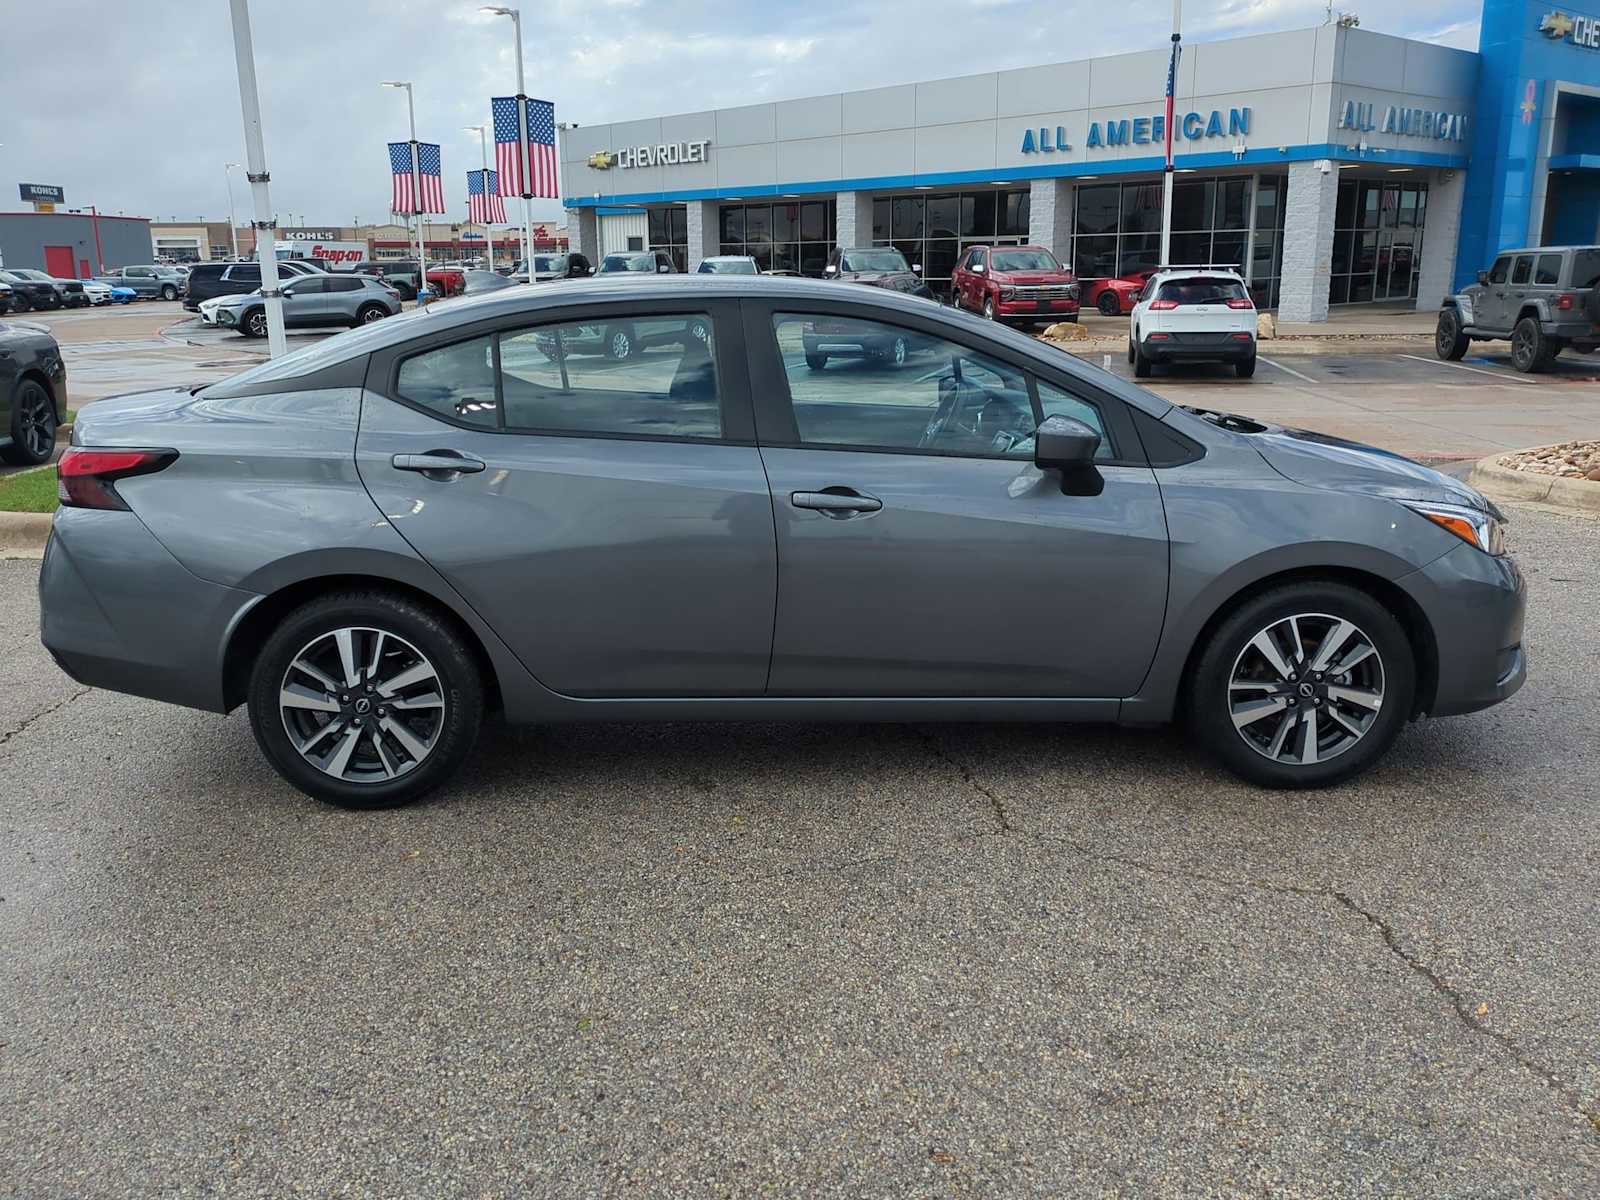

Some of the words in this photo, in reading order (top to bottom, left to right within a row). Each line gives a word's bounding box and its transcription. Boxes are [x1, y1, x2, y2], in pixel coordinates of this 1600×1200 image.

[1021, 127, 1072, 153] ALL
[1086, 107, 1251, 148] AMERICAN
[1338, 100, 1374, 133] ALL
[617, 140, 709, 169] CHEVROLET
[285, 232, 335, 240] KOHL'S
[312, 245, 363, 265] Snap-on
